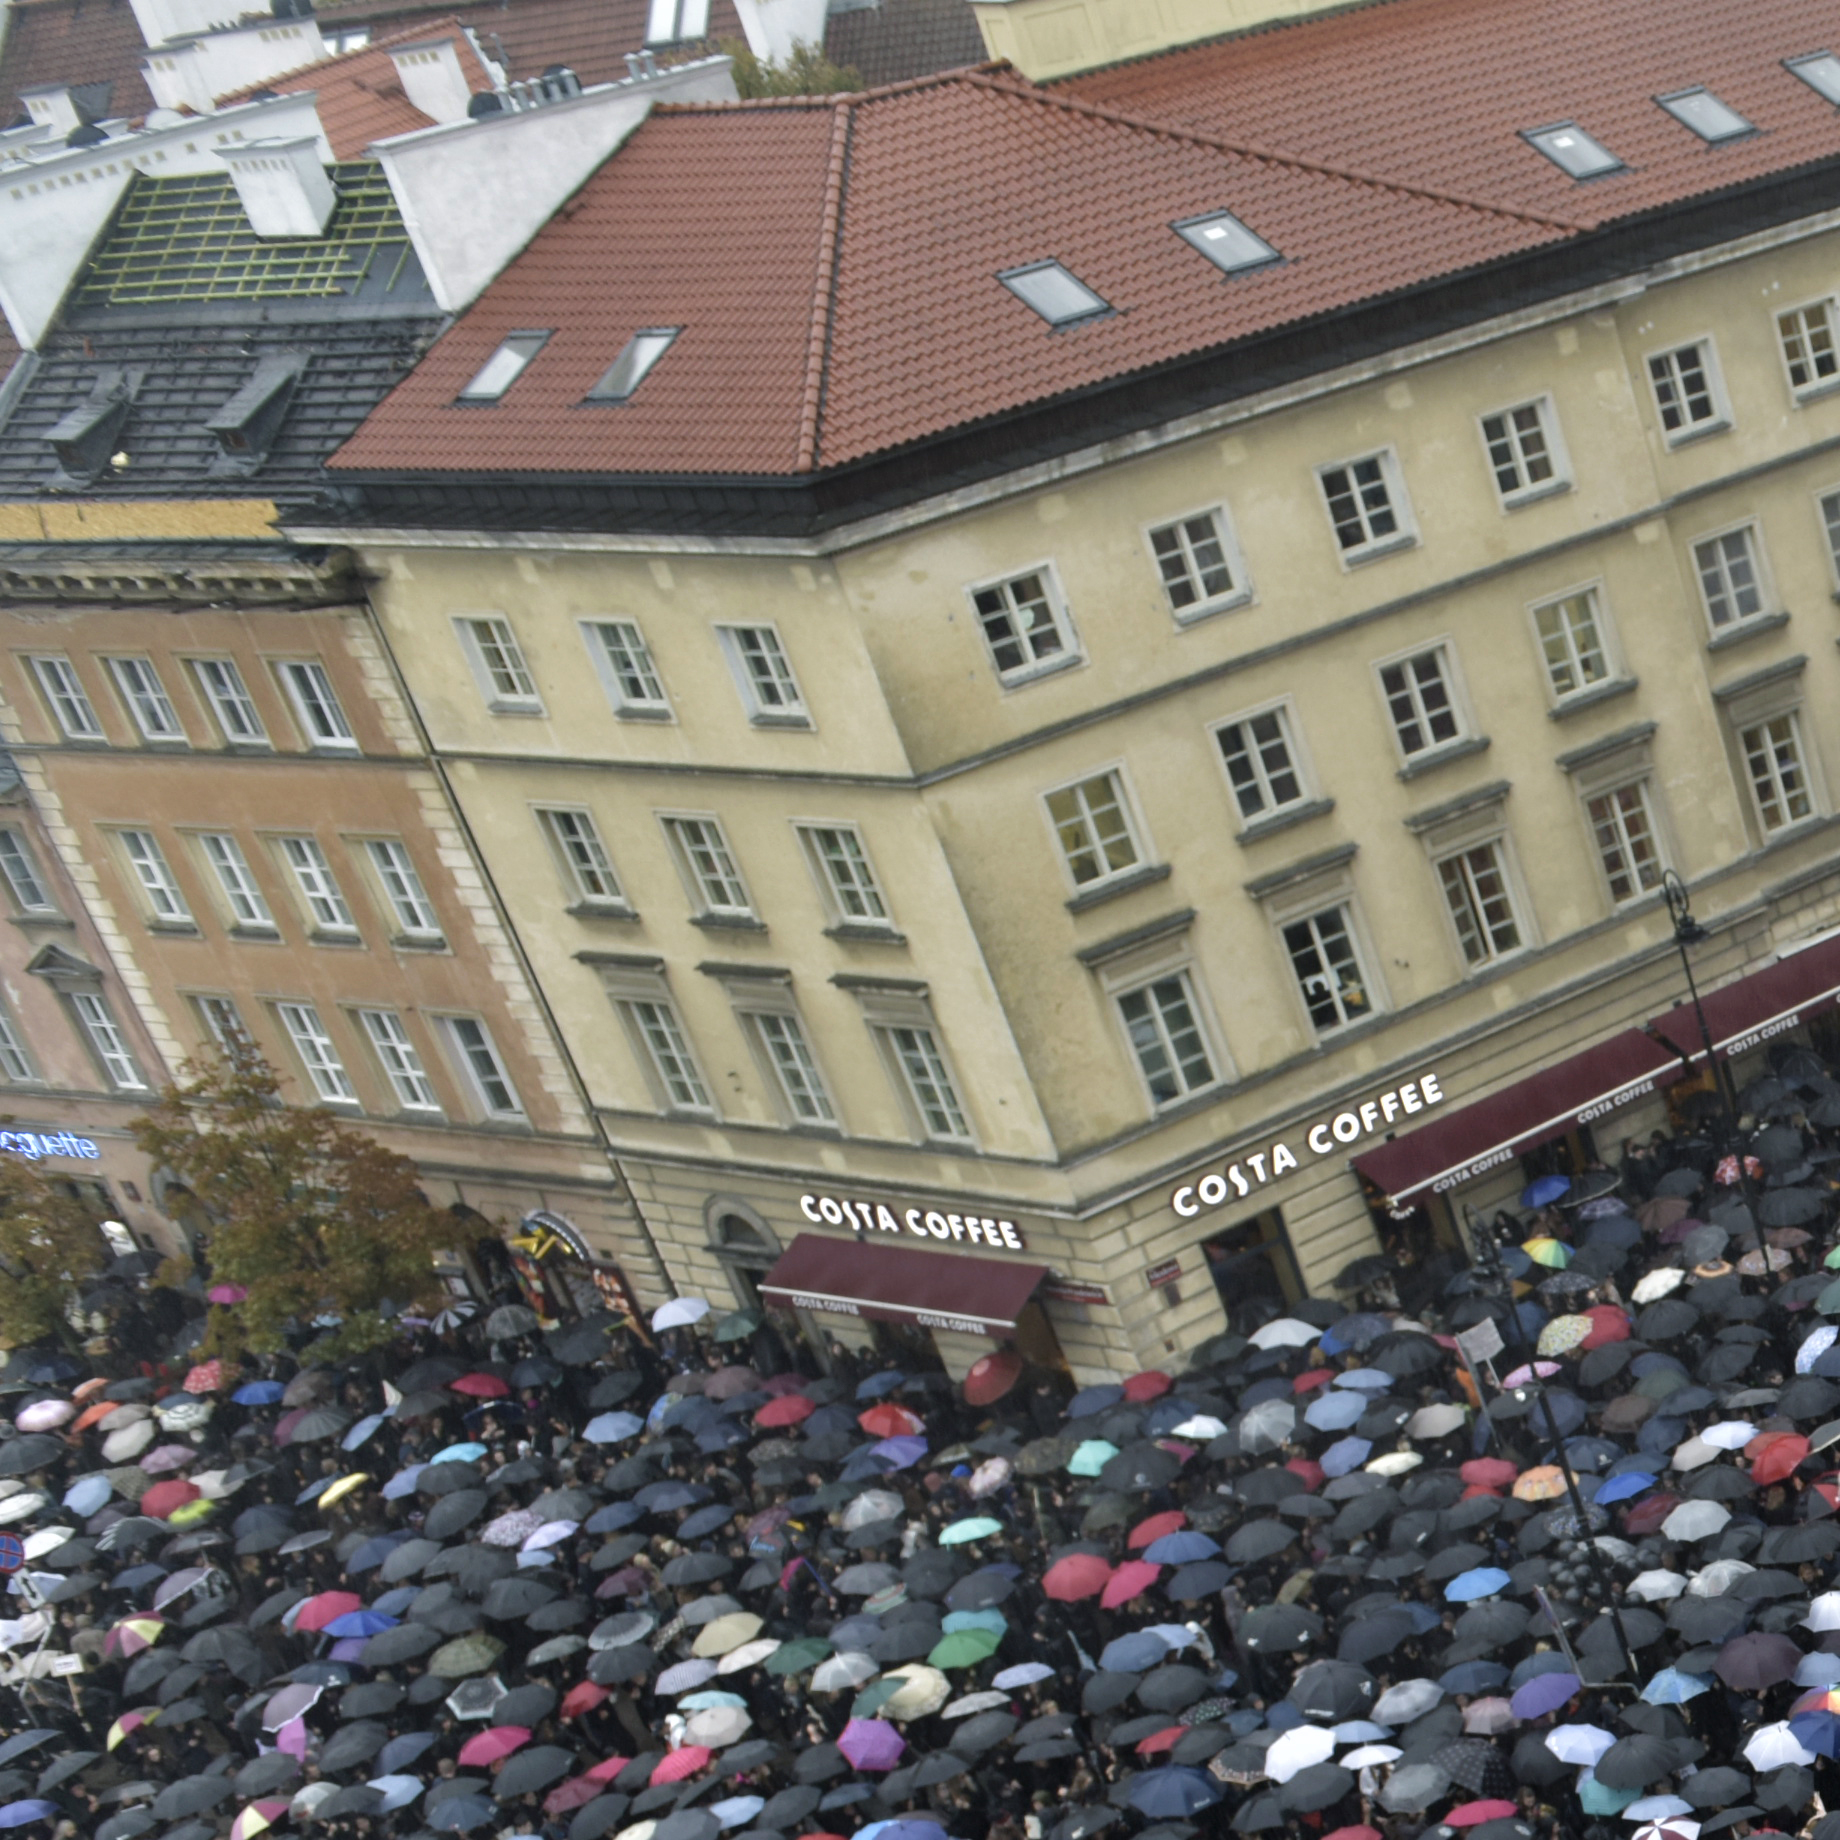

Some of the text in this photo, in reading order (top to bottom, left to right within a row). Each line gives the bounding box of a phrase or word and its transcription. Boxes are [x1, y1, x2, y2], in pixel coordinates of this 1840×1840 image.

[1726, 1015, 1799, 1056] COSTA COFFEE
[1578, 1080, 1655, 1124] COSTA COFFEE
[1172, 1073, 1444, 1217] COSTA COFFEE
[1432, 1147, 1514, 1193] COSTA COFFEE
[800, 1195, 1023, 1249] COSTA COFFEE
